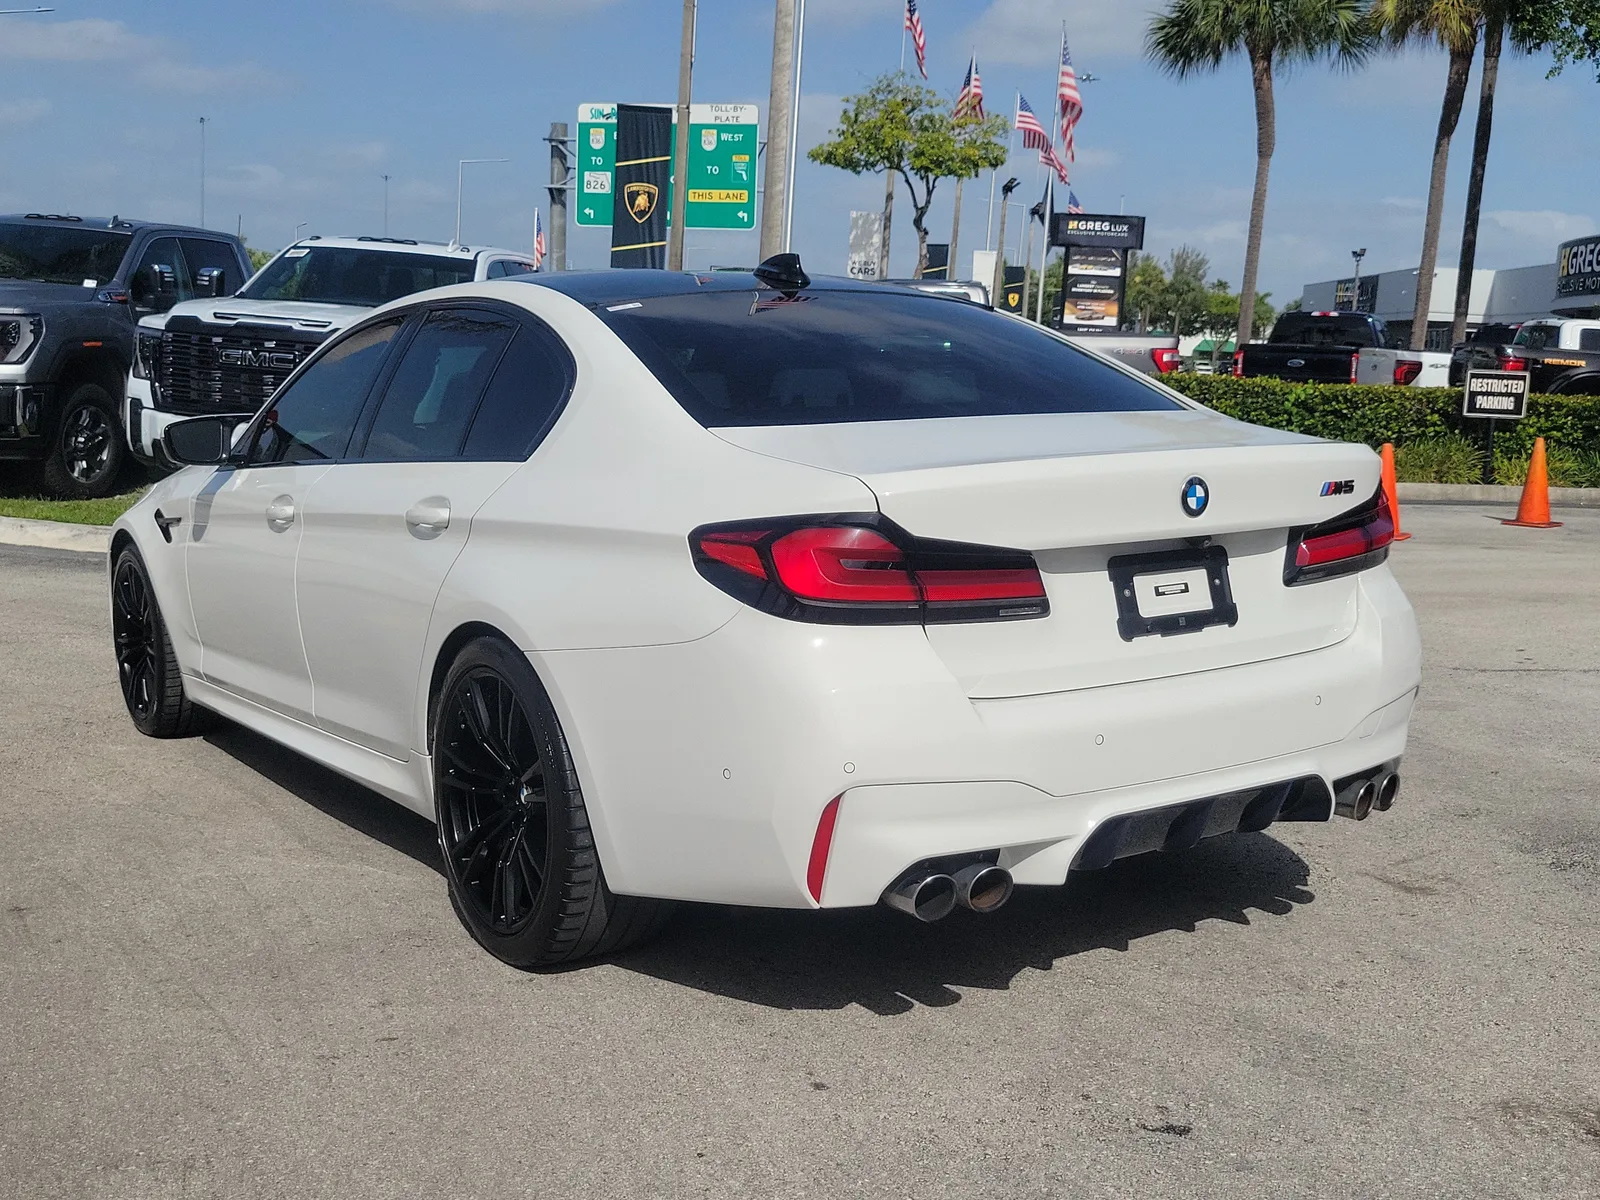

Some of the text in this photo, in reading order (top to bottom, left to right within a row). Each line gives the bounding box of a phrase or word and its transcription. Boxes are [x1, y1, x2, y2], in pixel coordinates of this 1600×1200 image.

[720, 132, 744, 142] WEST
[590, 156, 603, 166] TO
[706, 165, 720, 175] TO
[586, 180, 606, 190] 826
[691, 191, 745, 201] THIS LANE
[1111, 223, 1129, 232] LUX
[850, 266, 876, 276] CARS
[219, 349, 294, 369] GMC
[1470, 378, 1524, 394] RESTRICTED
[1475, 395, 1515, 410] PARKING
[1321, 480, 1355, 496] M5
